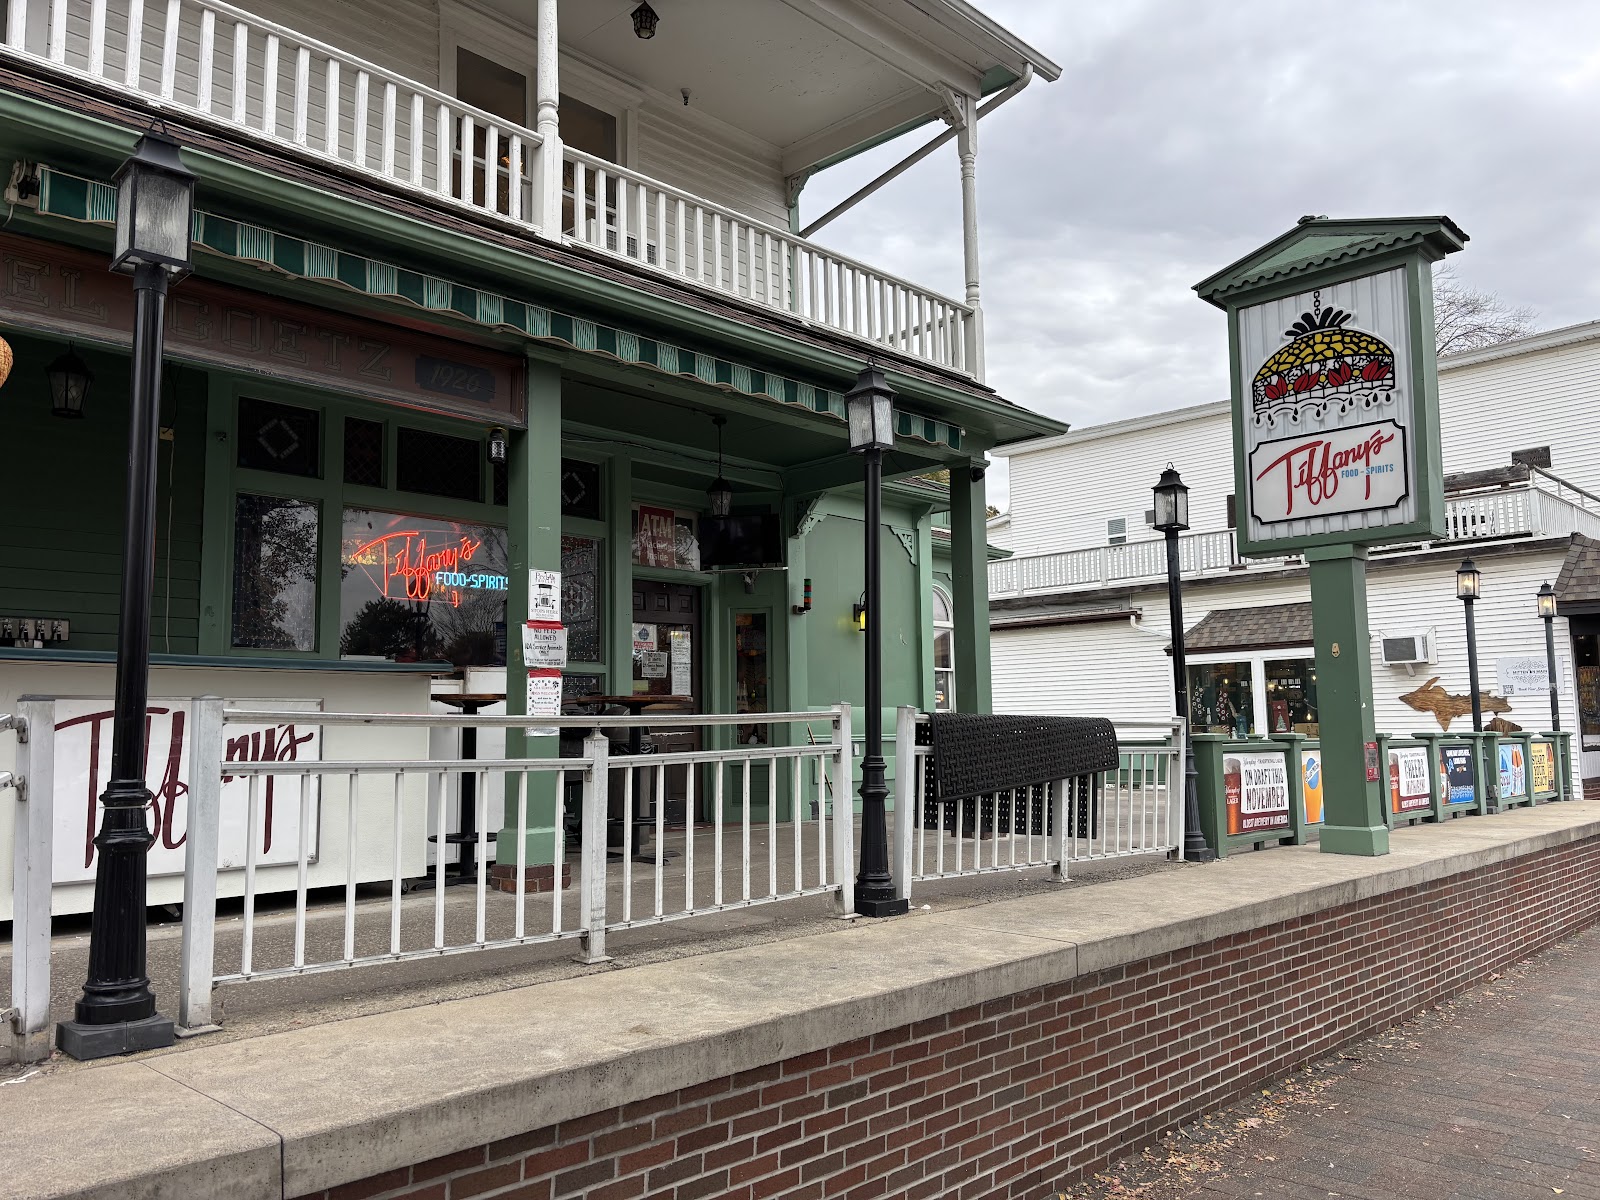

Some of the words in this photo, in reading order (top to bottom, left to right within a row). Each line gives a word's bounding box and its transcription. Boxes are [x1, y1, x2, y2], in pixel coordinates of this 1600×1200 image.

[168, 298, 393, 381] GOETZ
[429, 361, 481, 393] 1926
[1256, 429, 1395, 515] Tiffany's
[1341, 468, 1359, 479] FOOD
[1365, 463, 1394, 475] SPIRITS
[642, 513, 673, 539] ATM
[352, 530, 481, 608] Tiffany's
[534, 633, 557, 641] ALLOWED
[1244, 768, 1254, 787] ON
[1254, 768, 1272, 786] DRAFT
[1271, 767, 1284, 784] THIS
[1246, 785, 1286, 811] NOVEMBER
